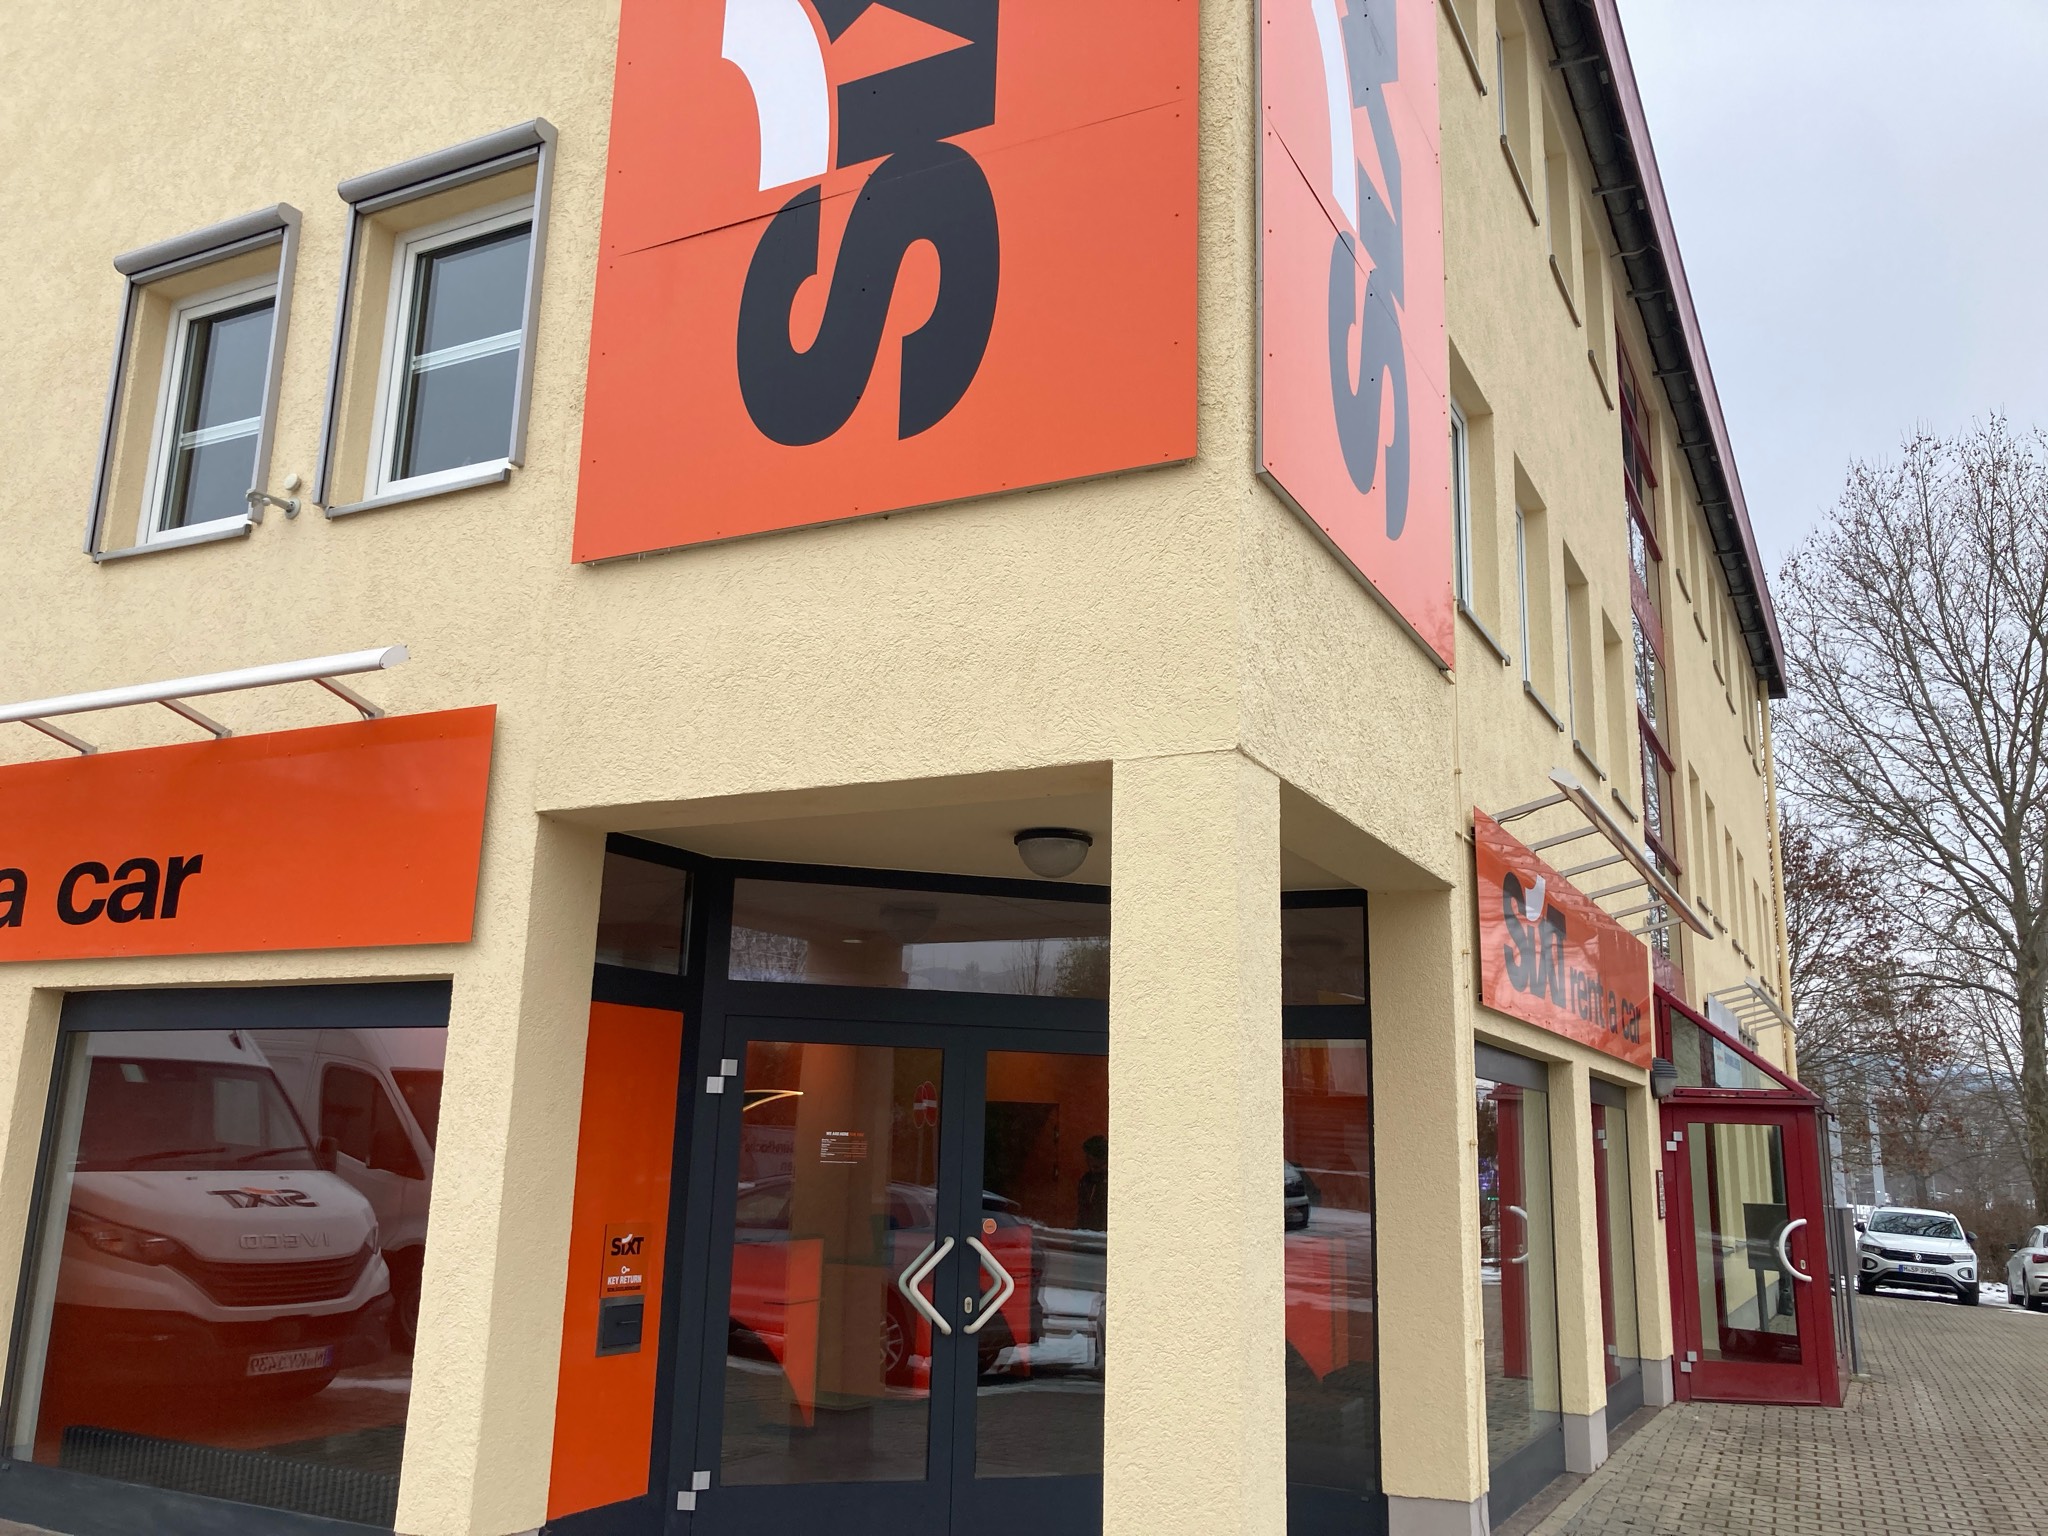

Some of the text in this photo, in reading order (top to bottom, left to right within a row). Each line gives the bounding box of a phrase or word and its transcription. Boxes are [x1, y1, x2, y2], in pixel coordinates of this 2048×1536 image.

[57, 854, 204, 926] car
[1569, 966, 1606, 1029] rent
[1608, 989, 1618, 1034] a
[1621, 997, 1641, 1045] car
[607, 1274, 642, 1286] KEY RETURN
